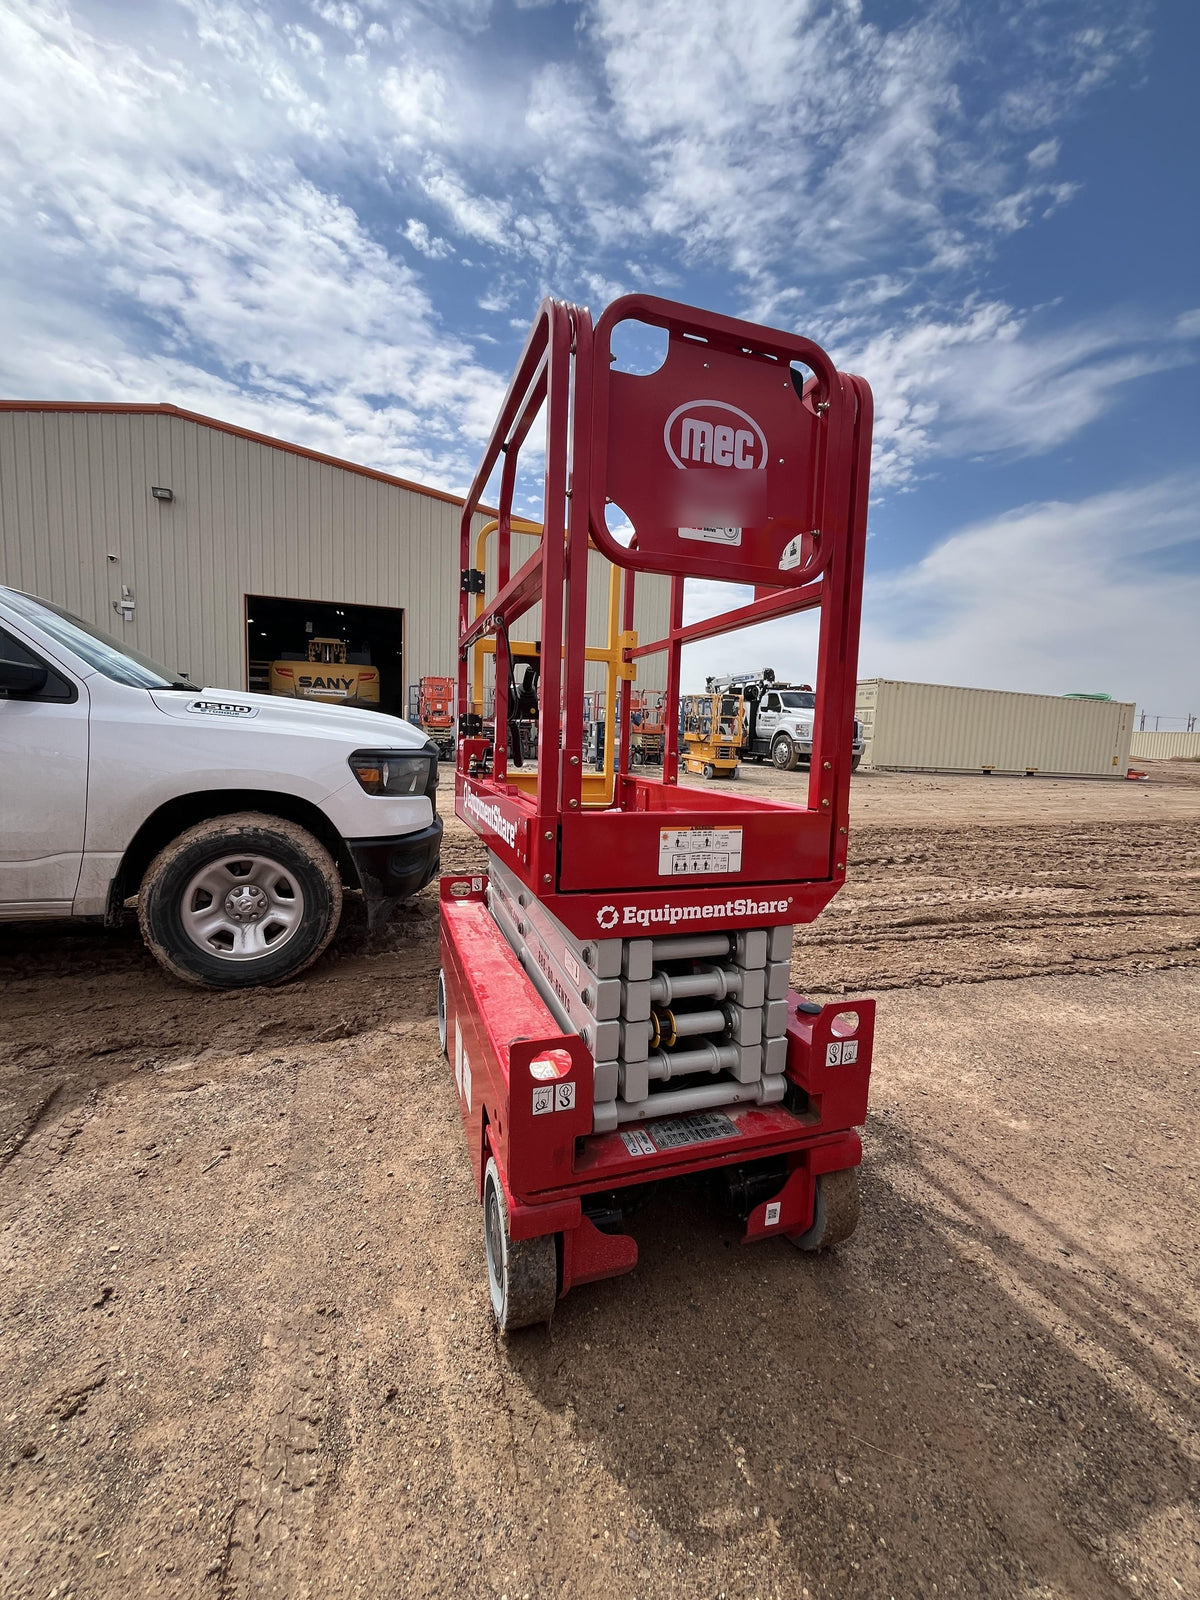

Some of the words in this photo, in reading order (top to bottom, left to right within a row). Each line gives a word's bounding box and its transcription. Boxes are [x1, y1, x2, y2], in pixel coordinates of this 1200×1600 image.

[298, 676, 355, 690] SANY
[200, 702, 249, 713] 1500
[467, 785, 516, 849] EquipmentShare
[622, 899, 789, 927] EquipmentShare
